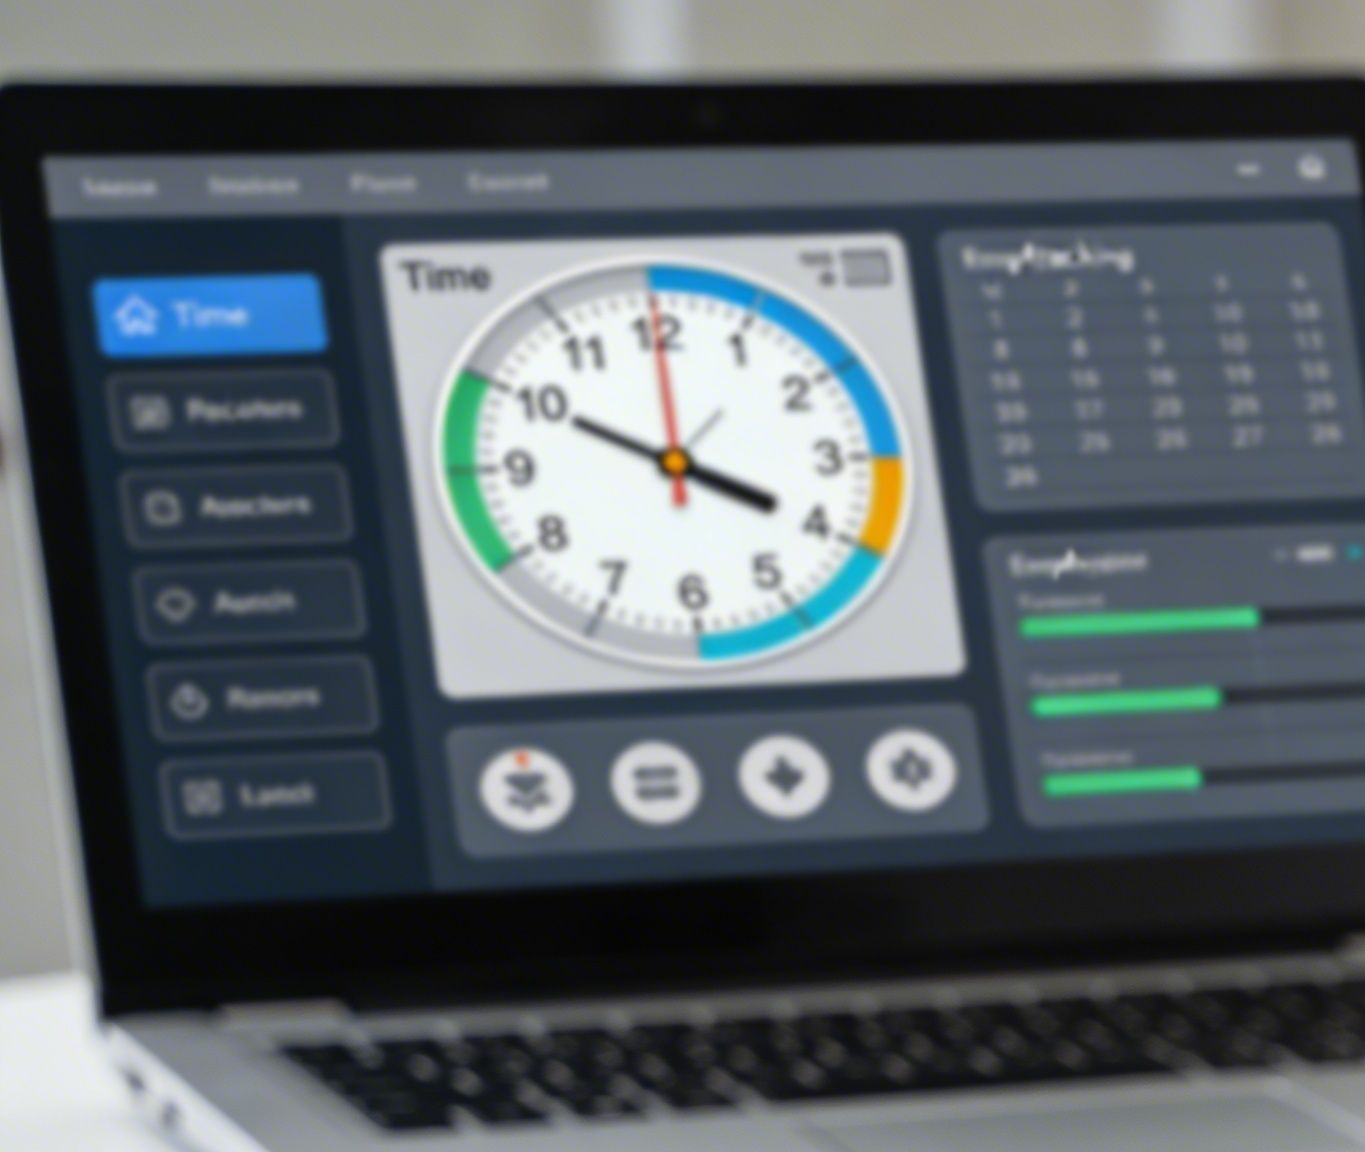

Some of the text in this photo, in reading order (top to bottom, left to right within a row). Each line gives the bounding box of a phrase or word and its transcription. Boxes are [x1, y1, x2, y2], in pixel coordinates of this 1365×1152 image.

[401, 260, 491, 294] Time
[172, 302, 249, 328] Time
[631, 315, 684, 352] 12
[727, 334, 747, 366] 1
[563, 335, 606, 370] 11
[517, 385, 568, 422] 10
[781, 375, 812, 412] 2
[503, 450, 536, 486] 9
[813, 440, 844, 476] 3
[537, 514, 569, 552] 8
[802, 505, 832, 540] 4
[601, 560, 628, 597] 7
[751, 554, 782, 590] 5
[677, 574, 709, 610] 6
